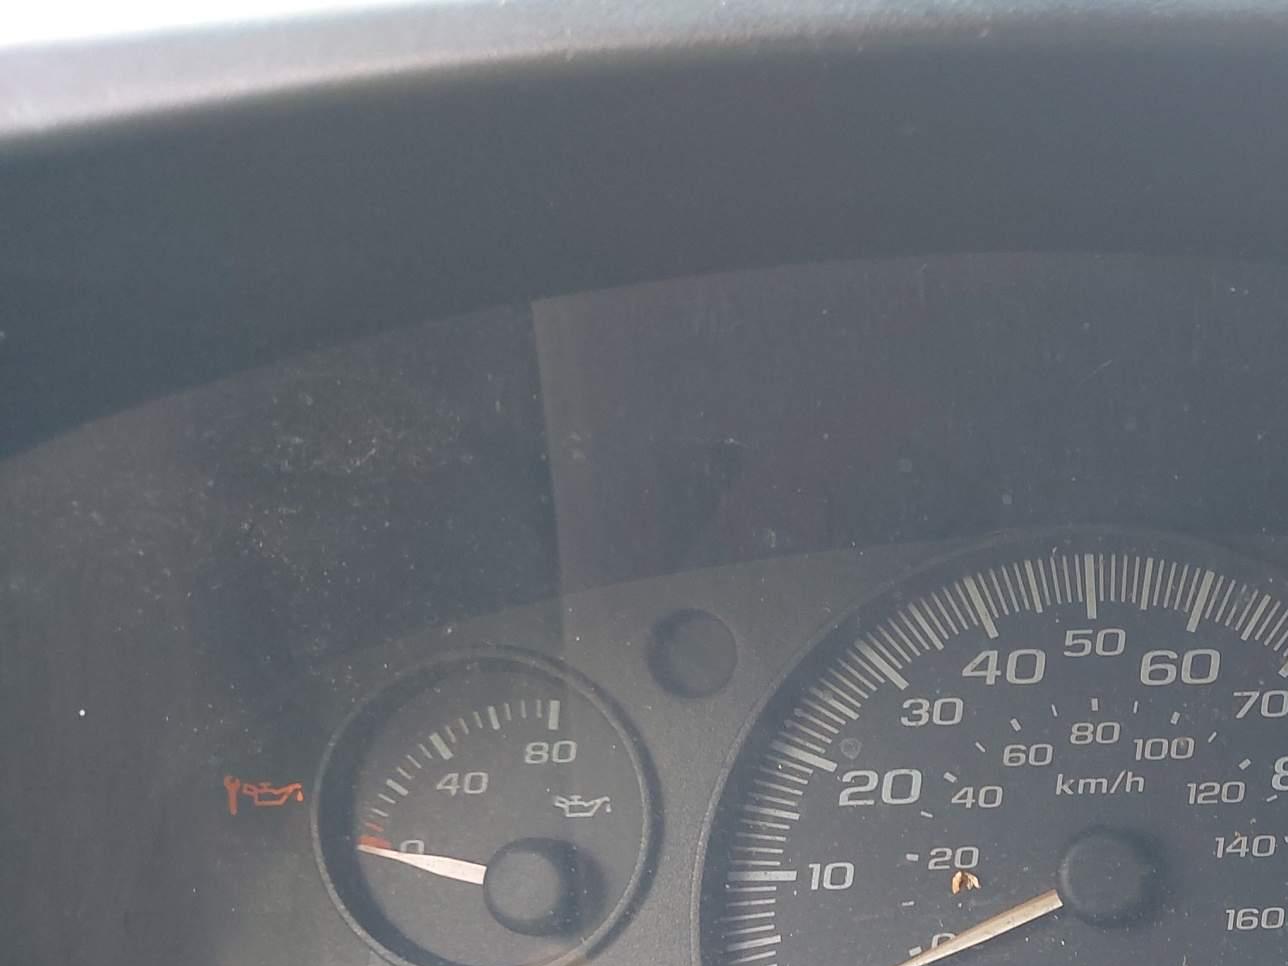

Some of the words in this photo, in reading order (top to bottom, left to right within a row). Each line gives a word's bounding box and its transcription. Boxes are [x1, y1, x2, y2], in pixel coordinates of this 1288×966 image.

[1063, 628, 1126, 657] 50
[962, 648, 1046, 685] 40
[1140, 648, 1221, 685] 60
[900, 697, 964, 727] 30
[1070, 721, 1121, 745] 80
[524, 740, 577, 764] 80
[1002, 743, 1053, 767] 60
[1133, 737, 1195, 761] 100
[436, 772, 489, 796] 40
[838, 768, 922, 807] 20
[1055, 770, 1145, 796] km/h
[1187, 781, 1246, 805] 120
[951, 786, 1003, 809] 40
[1215, 834, 1276, 858] 140
[927, 846, 980, 871] 20
[808, 862, 855, 891] 10
[1225, 907, 1285, 931] 160
